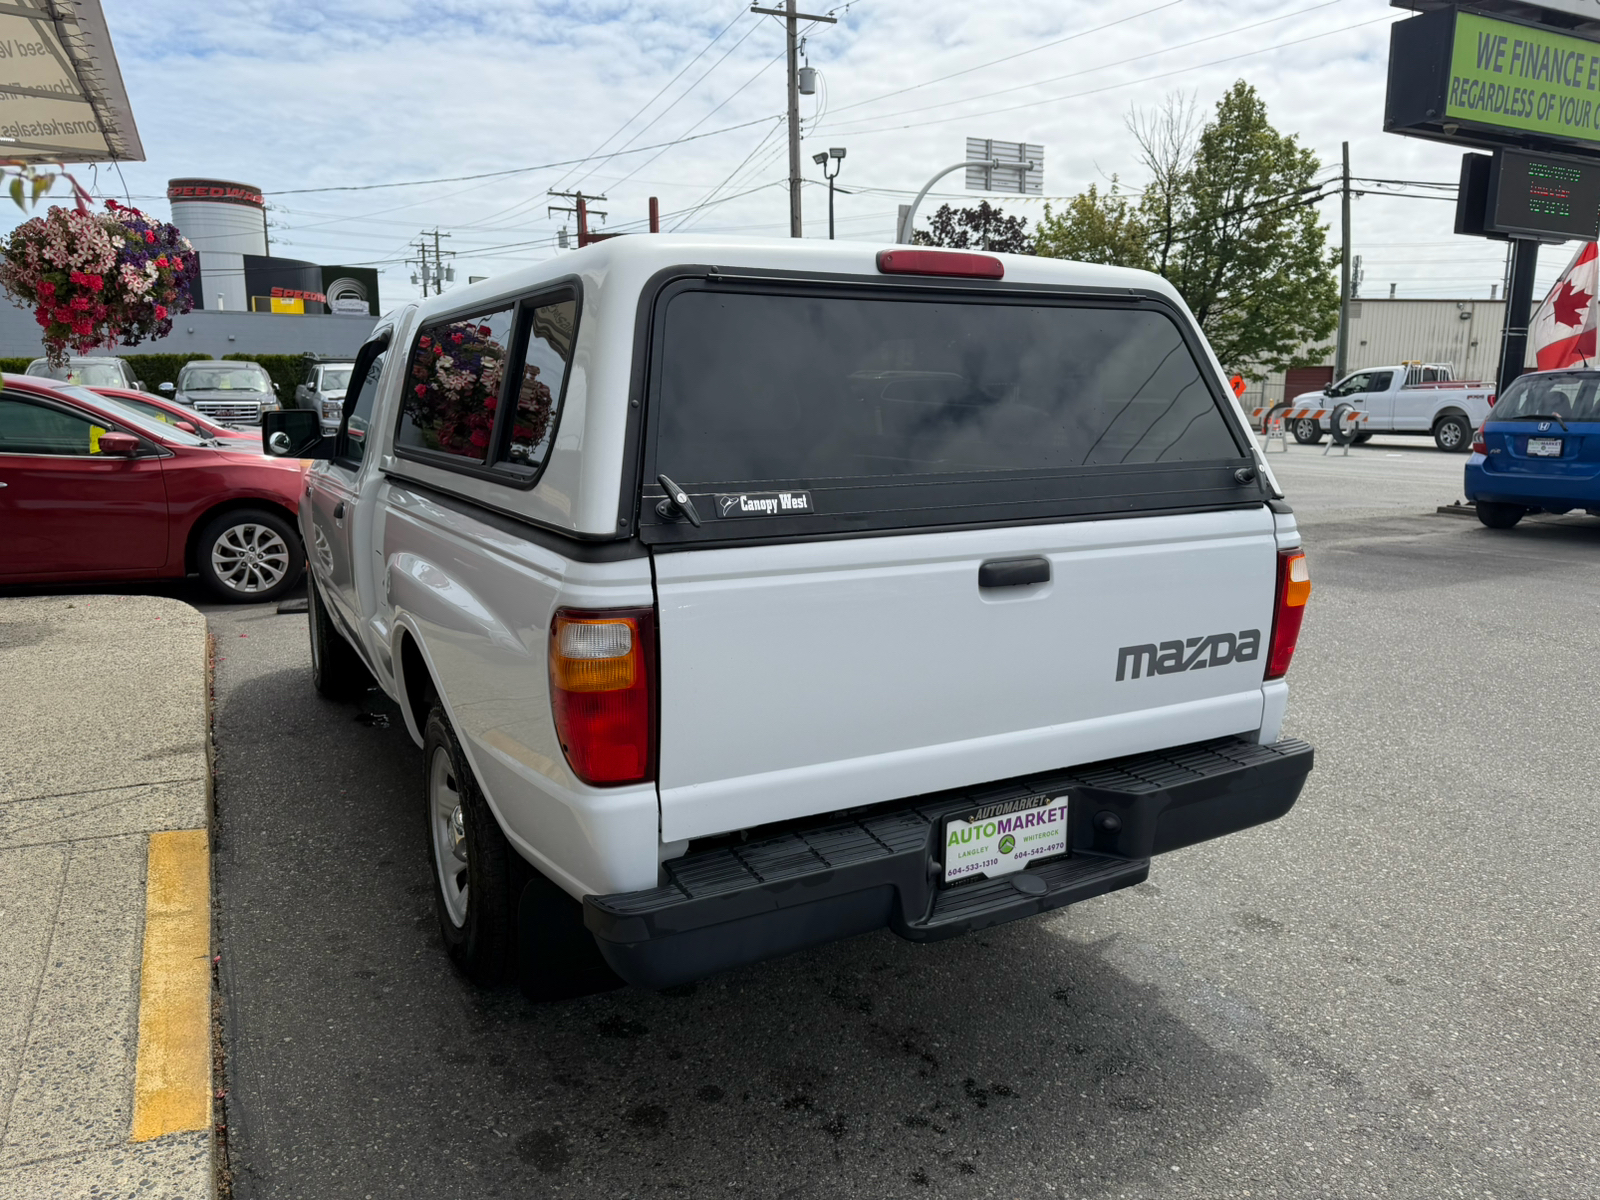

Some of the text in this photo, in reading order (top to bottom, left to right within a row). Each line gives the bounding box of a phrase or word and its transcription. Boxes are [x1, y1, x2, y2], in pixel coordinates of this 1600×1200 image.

[1476, 31, 1600, 92] WE FINANCE E
[1449, 75, 1535, 119] REGARDLESS
[1536, 91, 1556, 121] OF
[1557, 94, 1592, 128] YOUR
[740, 493, 808, 514] Canopy West
[974, 795, 1046, 821] AUTOMARKET
[947, 806, 1068, 847] AUTOMARKET
[1023, 829, 1059, 843] WHITEROCK
[957, 846, 989, 859] LANGLEY
[1014, 842, 1064, 860] 604-542-4970
[947, 858, 998, 877] 604-533-1310
